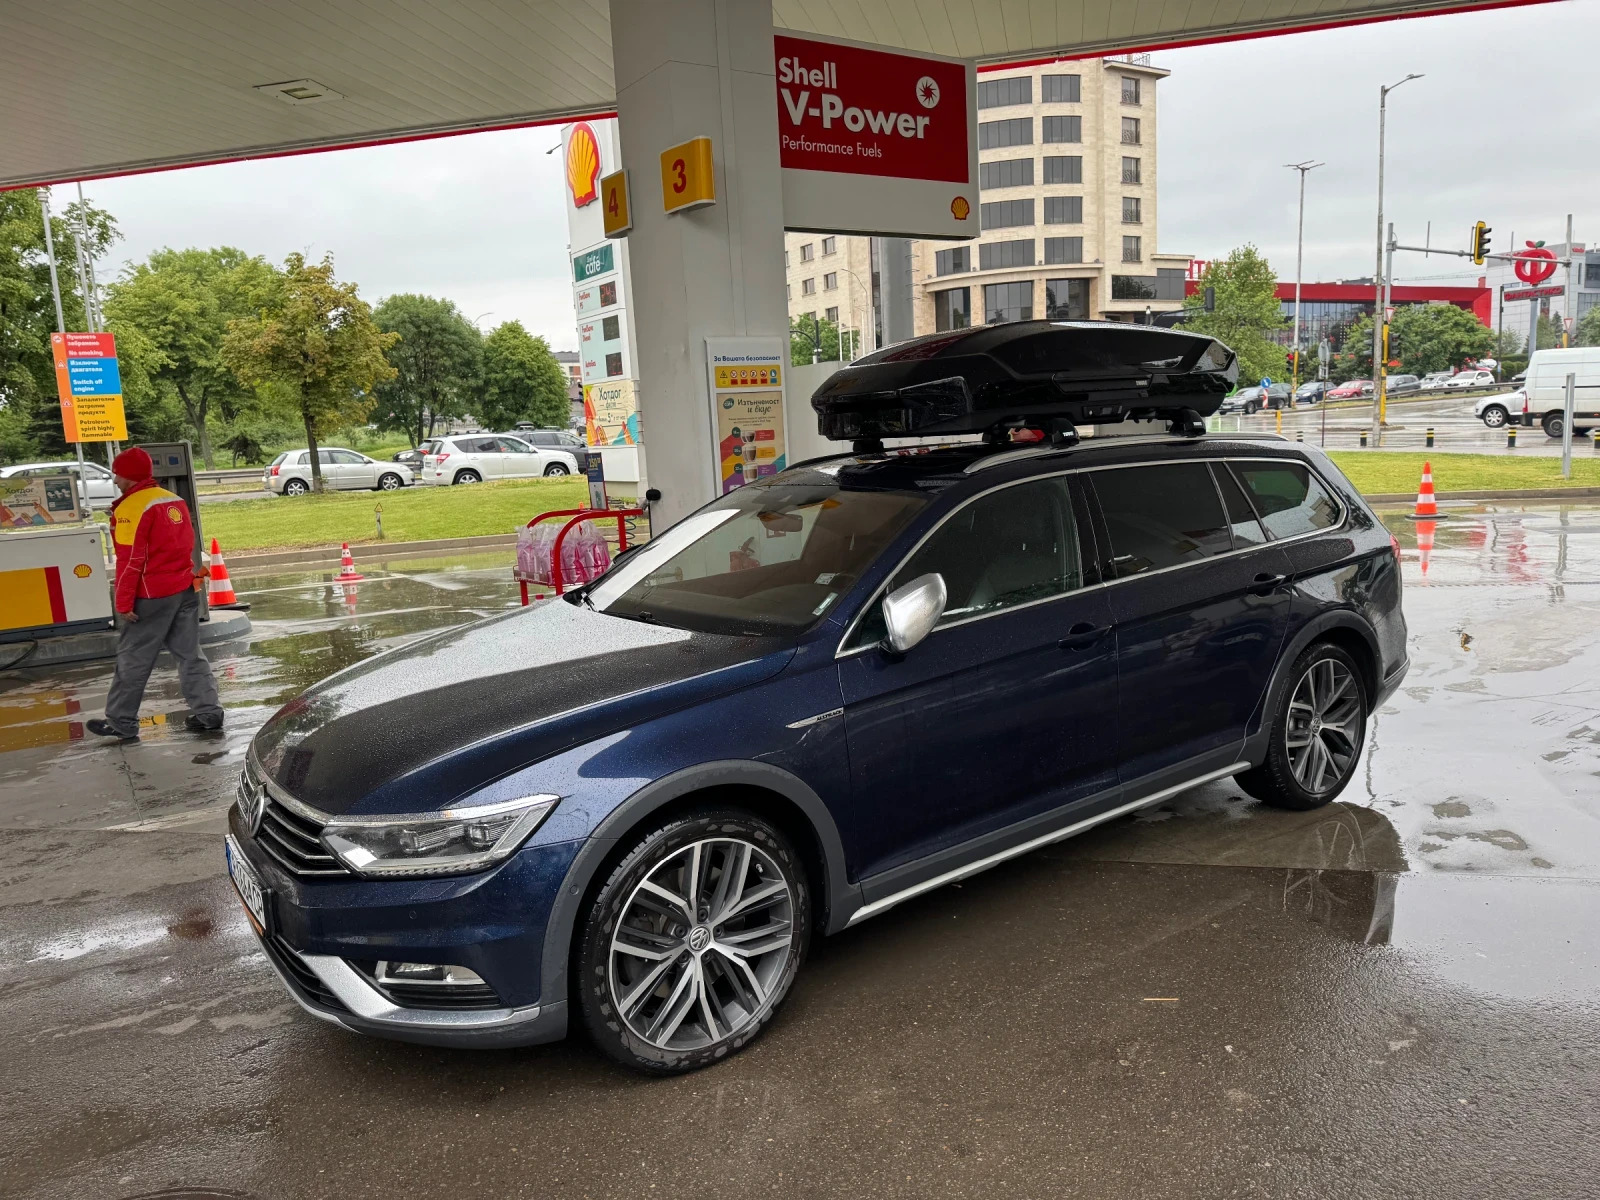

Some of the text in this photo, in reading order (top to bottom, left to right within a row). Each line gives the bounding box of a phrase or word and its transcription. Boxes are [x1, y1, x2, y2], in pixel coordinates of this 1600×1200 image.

[778, 56, 837, 89] Shell
[780, 88, 930, 139] V-Power
[782, 134, 883, 158] Performance Fuels
[672, 158, 687, 194] 3
[608, 186, 619, 218] 4
[585, 256, 601, 276] café
[598, 387, 622, 401] Хотдог
